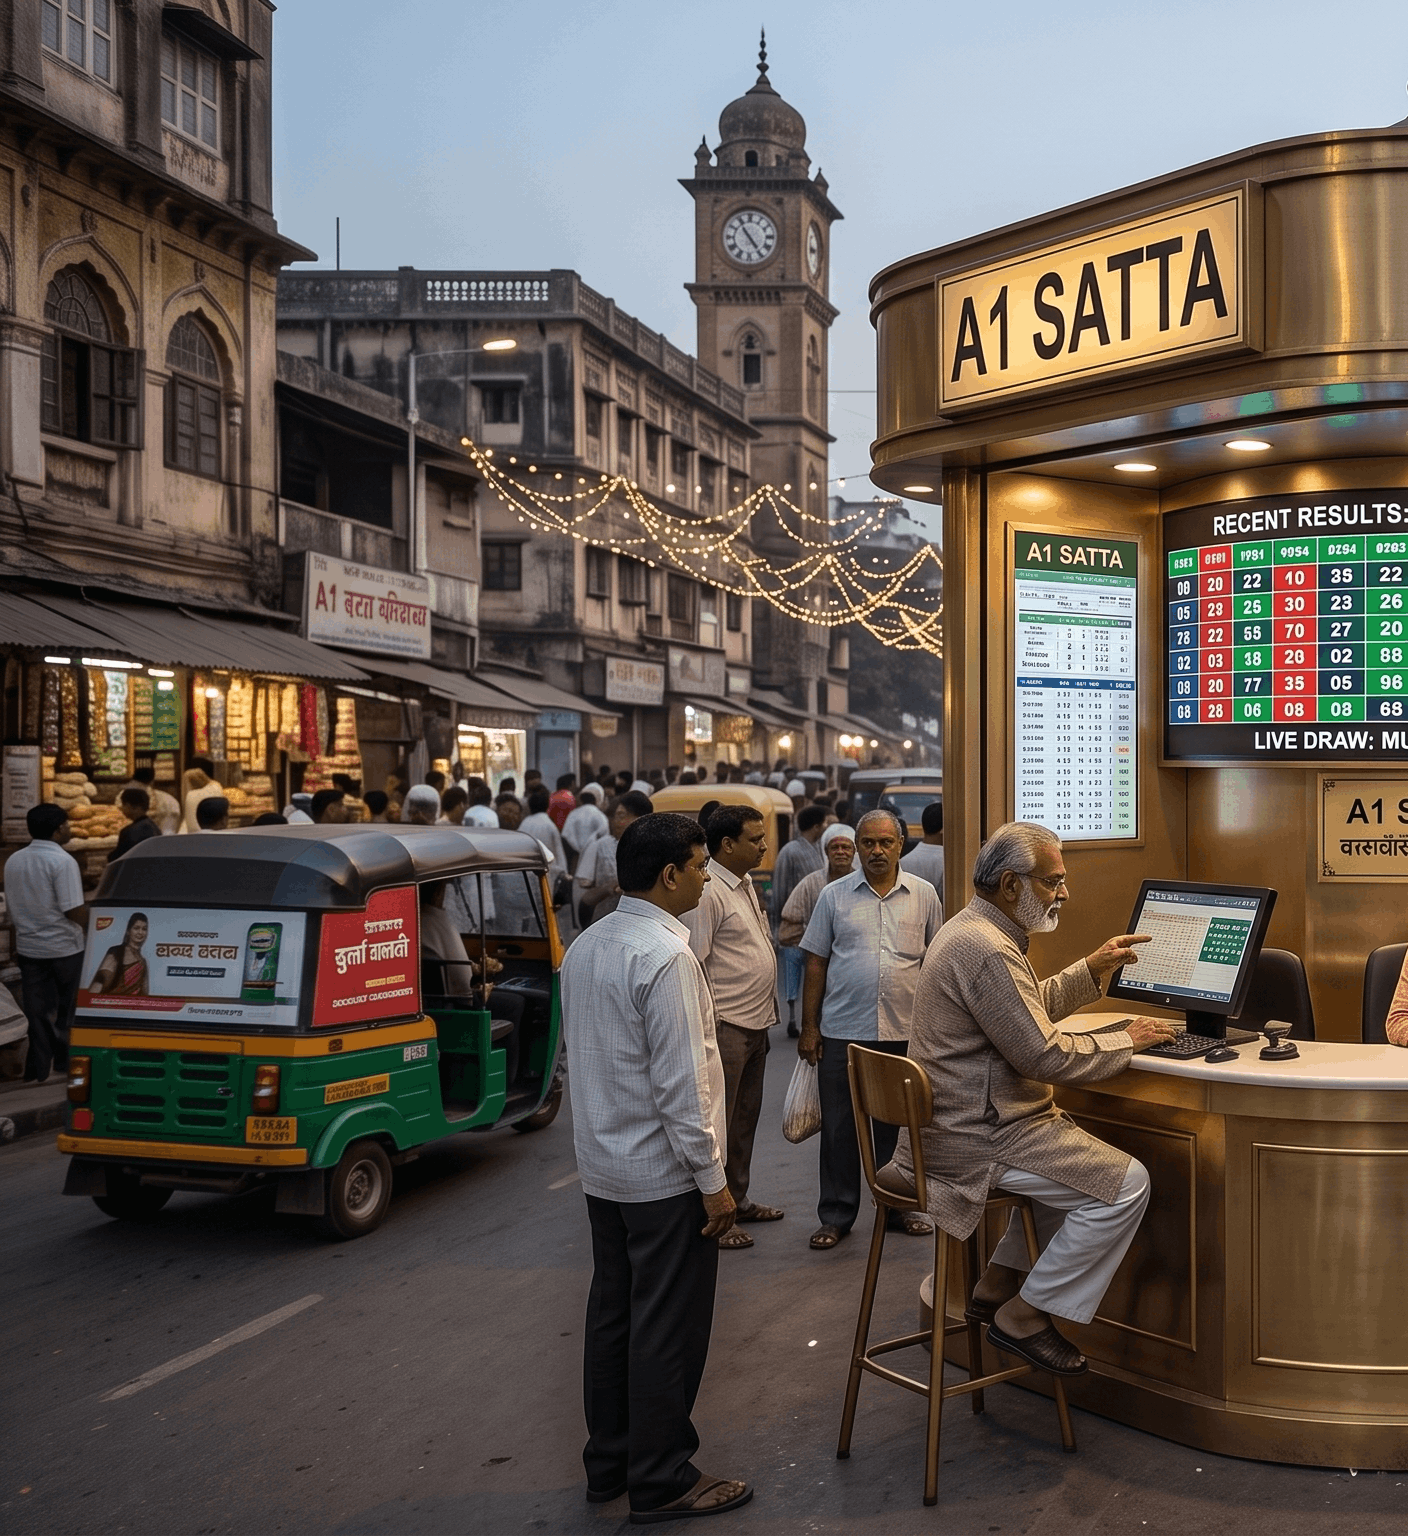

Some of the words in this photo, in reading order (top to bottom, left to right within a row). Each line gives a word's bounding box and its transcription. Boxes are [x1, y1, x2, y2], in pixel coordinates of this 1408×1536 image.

[951, 285, 1008, 383] A1
[1032, 228, 1229, 360] SATTA
[1213, 508, 1292, 536] RECENT
[1298, 503, 1408, 527] RESULTS:
[1026, 541, 1052, 563] A1
[1059, 545, 1124, 569] SATTA
[1207, 576, 1224, 592] 20
[1242, 573, 1262, 589] 22
[1284, 570, 1305, 586] 10
[1379, 566, 1403, 582] 22
[315, 580, 337, 613] A1
[1177, 605, 1191, 621] 05
[1243, 599, 1262, 615] 25
[1284, 596, 1305, 612] 30
[1330, 594, 1353, 611] 23
[1379, 593, 1403, 609] 26
[1207, 627, 1224, 643] 22
[1284, 622, 1305, 639] 70
[1330, 621, 1353, 637] 27
[1379, 620, 1403, 636] 20
[1207, 653, 1224, 668] 03
[1330, 647, 1353, 664] 02
[1380, 647, 1403, 663] 88
[1208, 678, 1224, 693] 20
[1243, 677, 1262, 693] 77
[1284, 675, 1305, 691] 35
[1330, 675, 1353, 691] 05
[1380, 674, 1403, 690] 96
[1243, 702, 1262, 718] 06
[1284, 702, 1305, 717] 08
[1254, 731, 1298, 750] LIVE
[1304, 731, 1374, 750] DRAW:
[1346, 798, 1383, 825] A1
